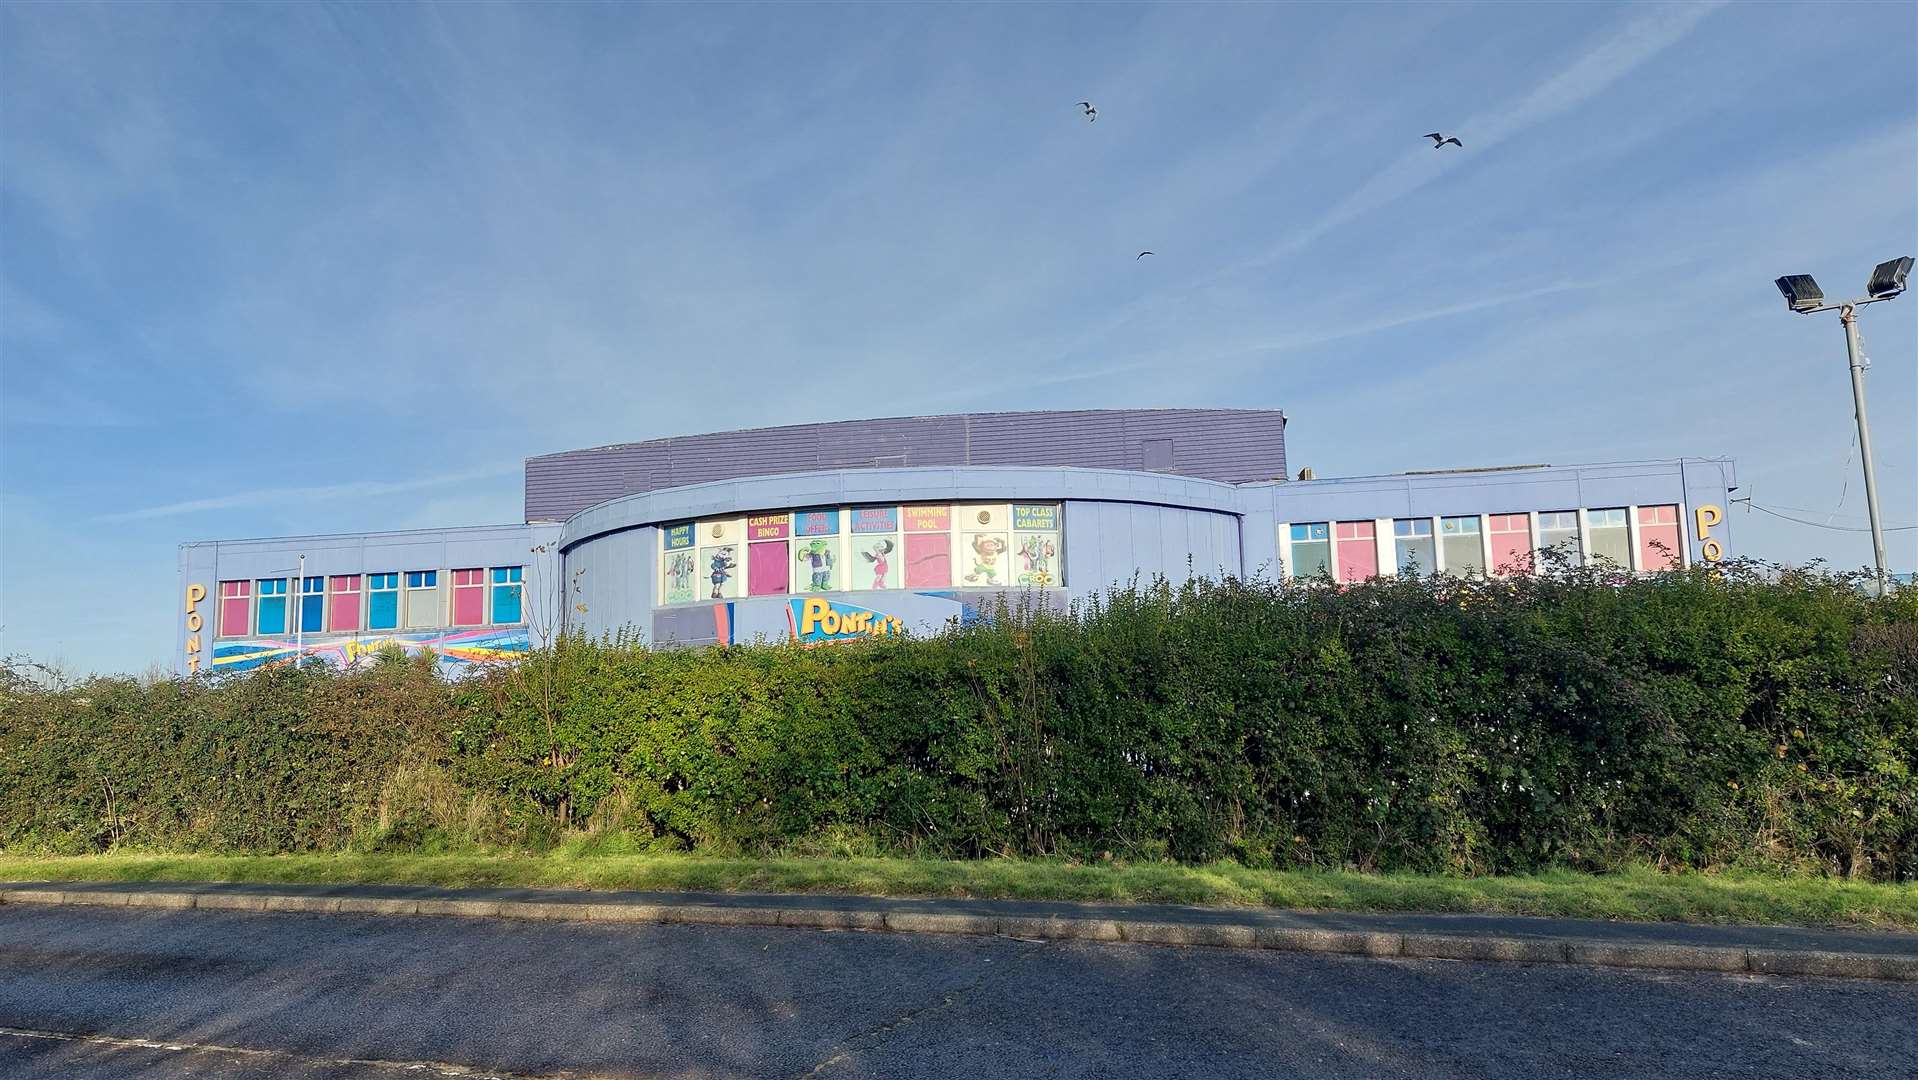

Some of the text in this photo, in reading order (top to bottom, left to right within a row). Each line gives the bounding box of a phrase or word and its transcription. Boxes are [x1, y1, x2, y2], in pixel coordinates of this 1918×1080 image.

[907, 508, 948, 518] SWIMMING
[1016, 507, 1054, 517] TOP CLASS
[749, 514, 789, 527] CASH PRIZE
[917, 519, 938, 529] POOL
[1016, 518, 1054, 529] CABARETS
[671, 525, 689, 536] HAPPY
[757, 526, 779, 538] BINGO
[1018, 572, 1055, 585] CROC
